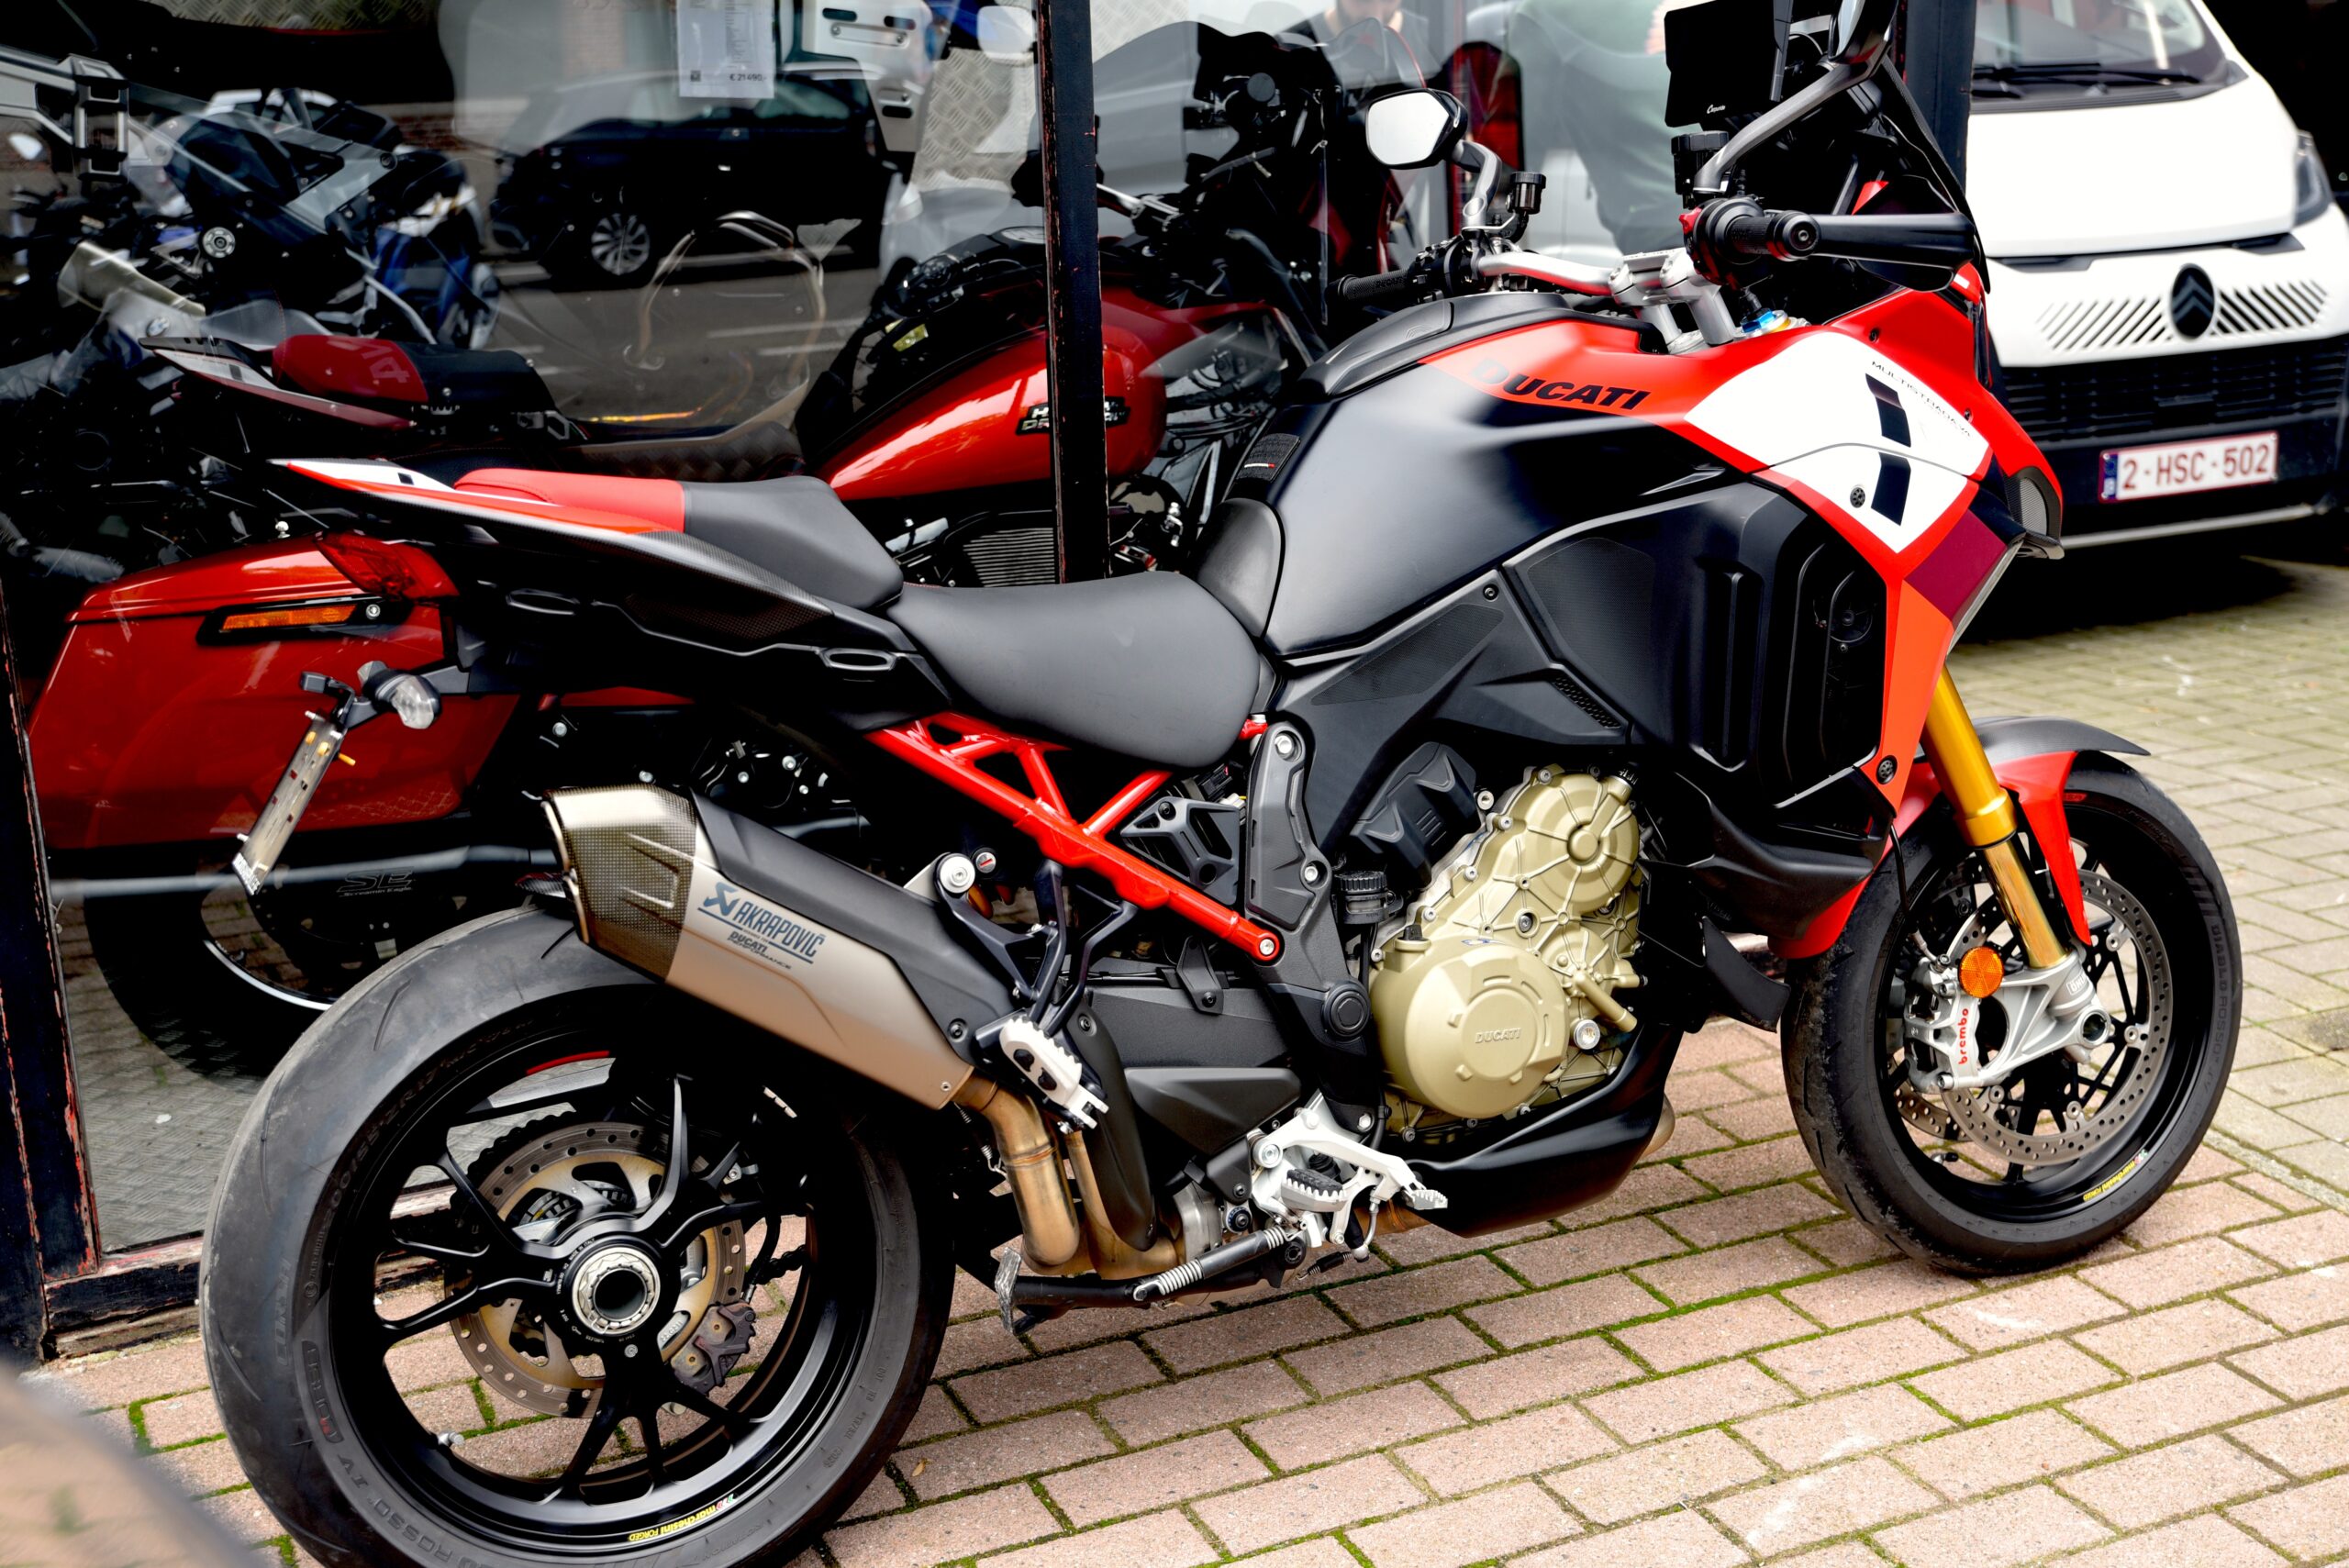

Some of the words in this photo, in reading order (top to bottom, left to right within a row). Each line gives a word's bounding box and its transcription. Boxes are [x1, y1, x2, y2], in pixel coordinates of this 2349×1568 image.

[1473, 359, 1652, 410] DUCATI
[729, 930, 768, 953] DUCATI
[1475, 1027, 1522, 1044] DUCATI
[1957, 1007, 1969, 1065] brembo
[661, 1505, 716, 1535] marchesini
[628, 1528, 660, 1541] FORGED
